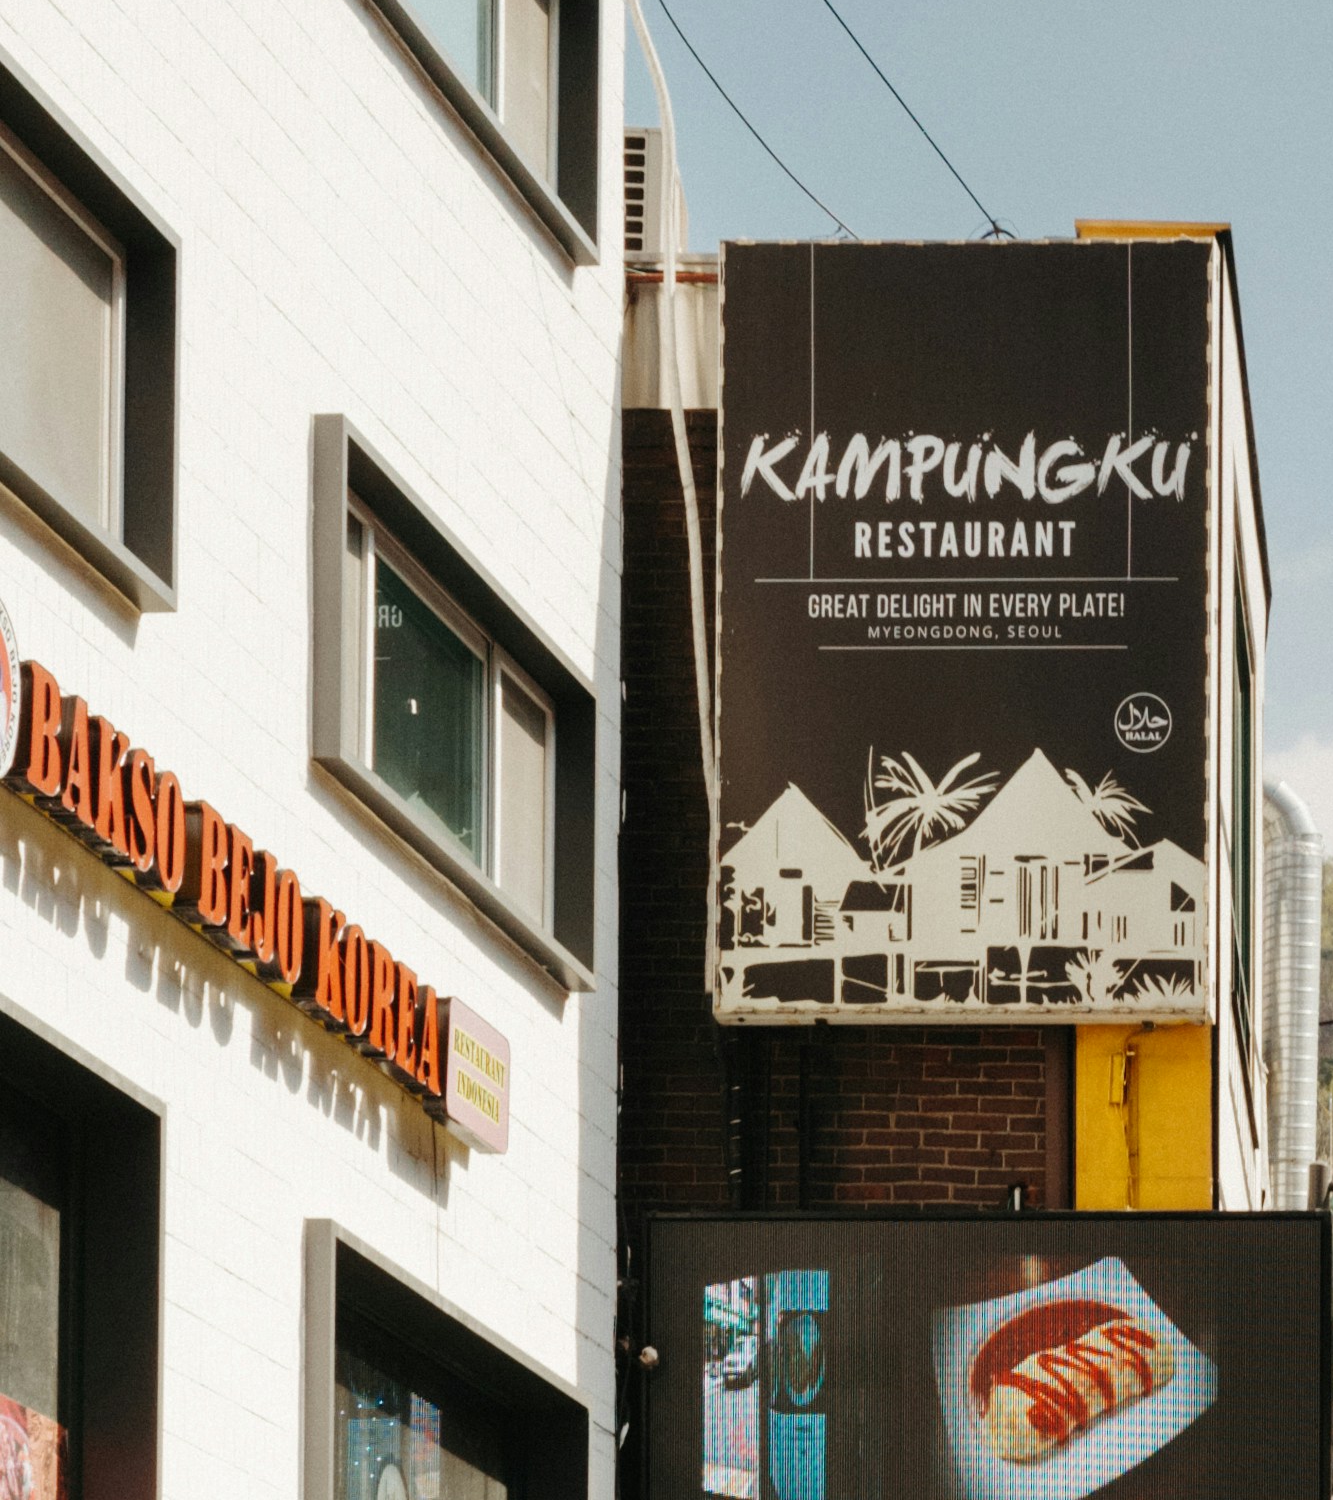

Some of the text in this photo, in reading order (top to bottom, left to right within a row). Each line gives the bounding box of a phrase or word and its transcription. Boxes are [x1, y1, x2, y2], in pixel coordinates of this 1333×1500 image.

[741, 430, 1196, 504] KAMPUNGKU
[854, 519, 1077, 558] RESTAURANT
[808, 593, 1125, 619] GREAT DELIGHT IN EVERY PLATE!
[868, 626, 1062, 641] MYEONGDONG, SEOUL
[1125, 731, 1161, 741] HALAL
[27, 660, 442, 1097] BAKSO BEJO KOREA
[453, 1027, 506, 1089] RESTAURANT
[456, 1069, 501, 1126] INDONESIA
